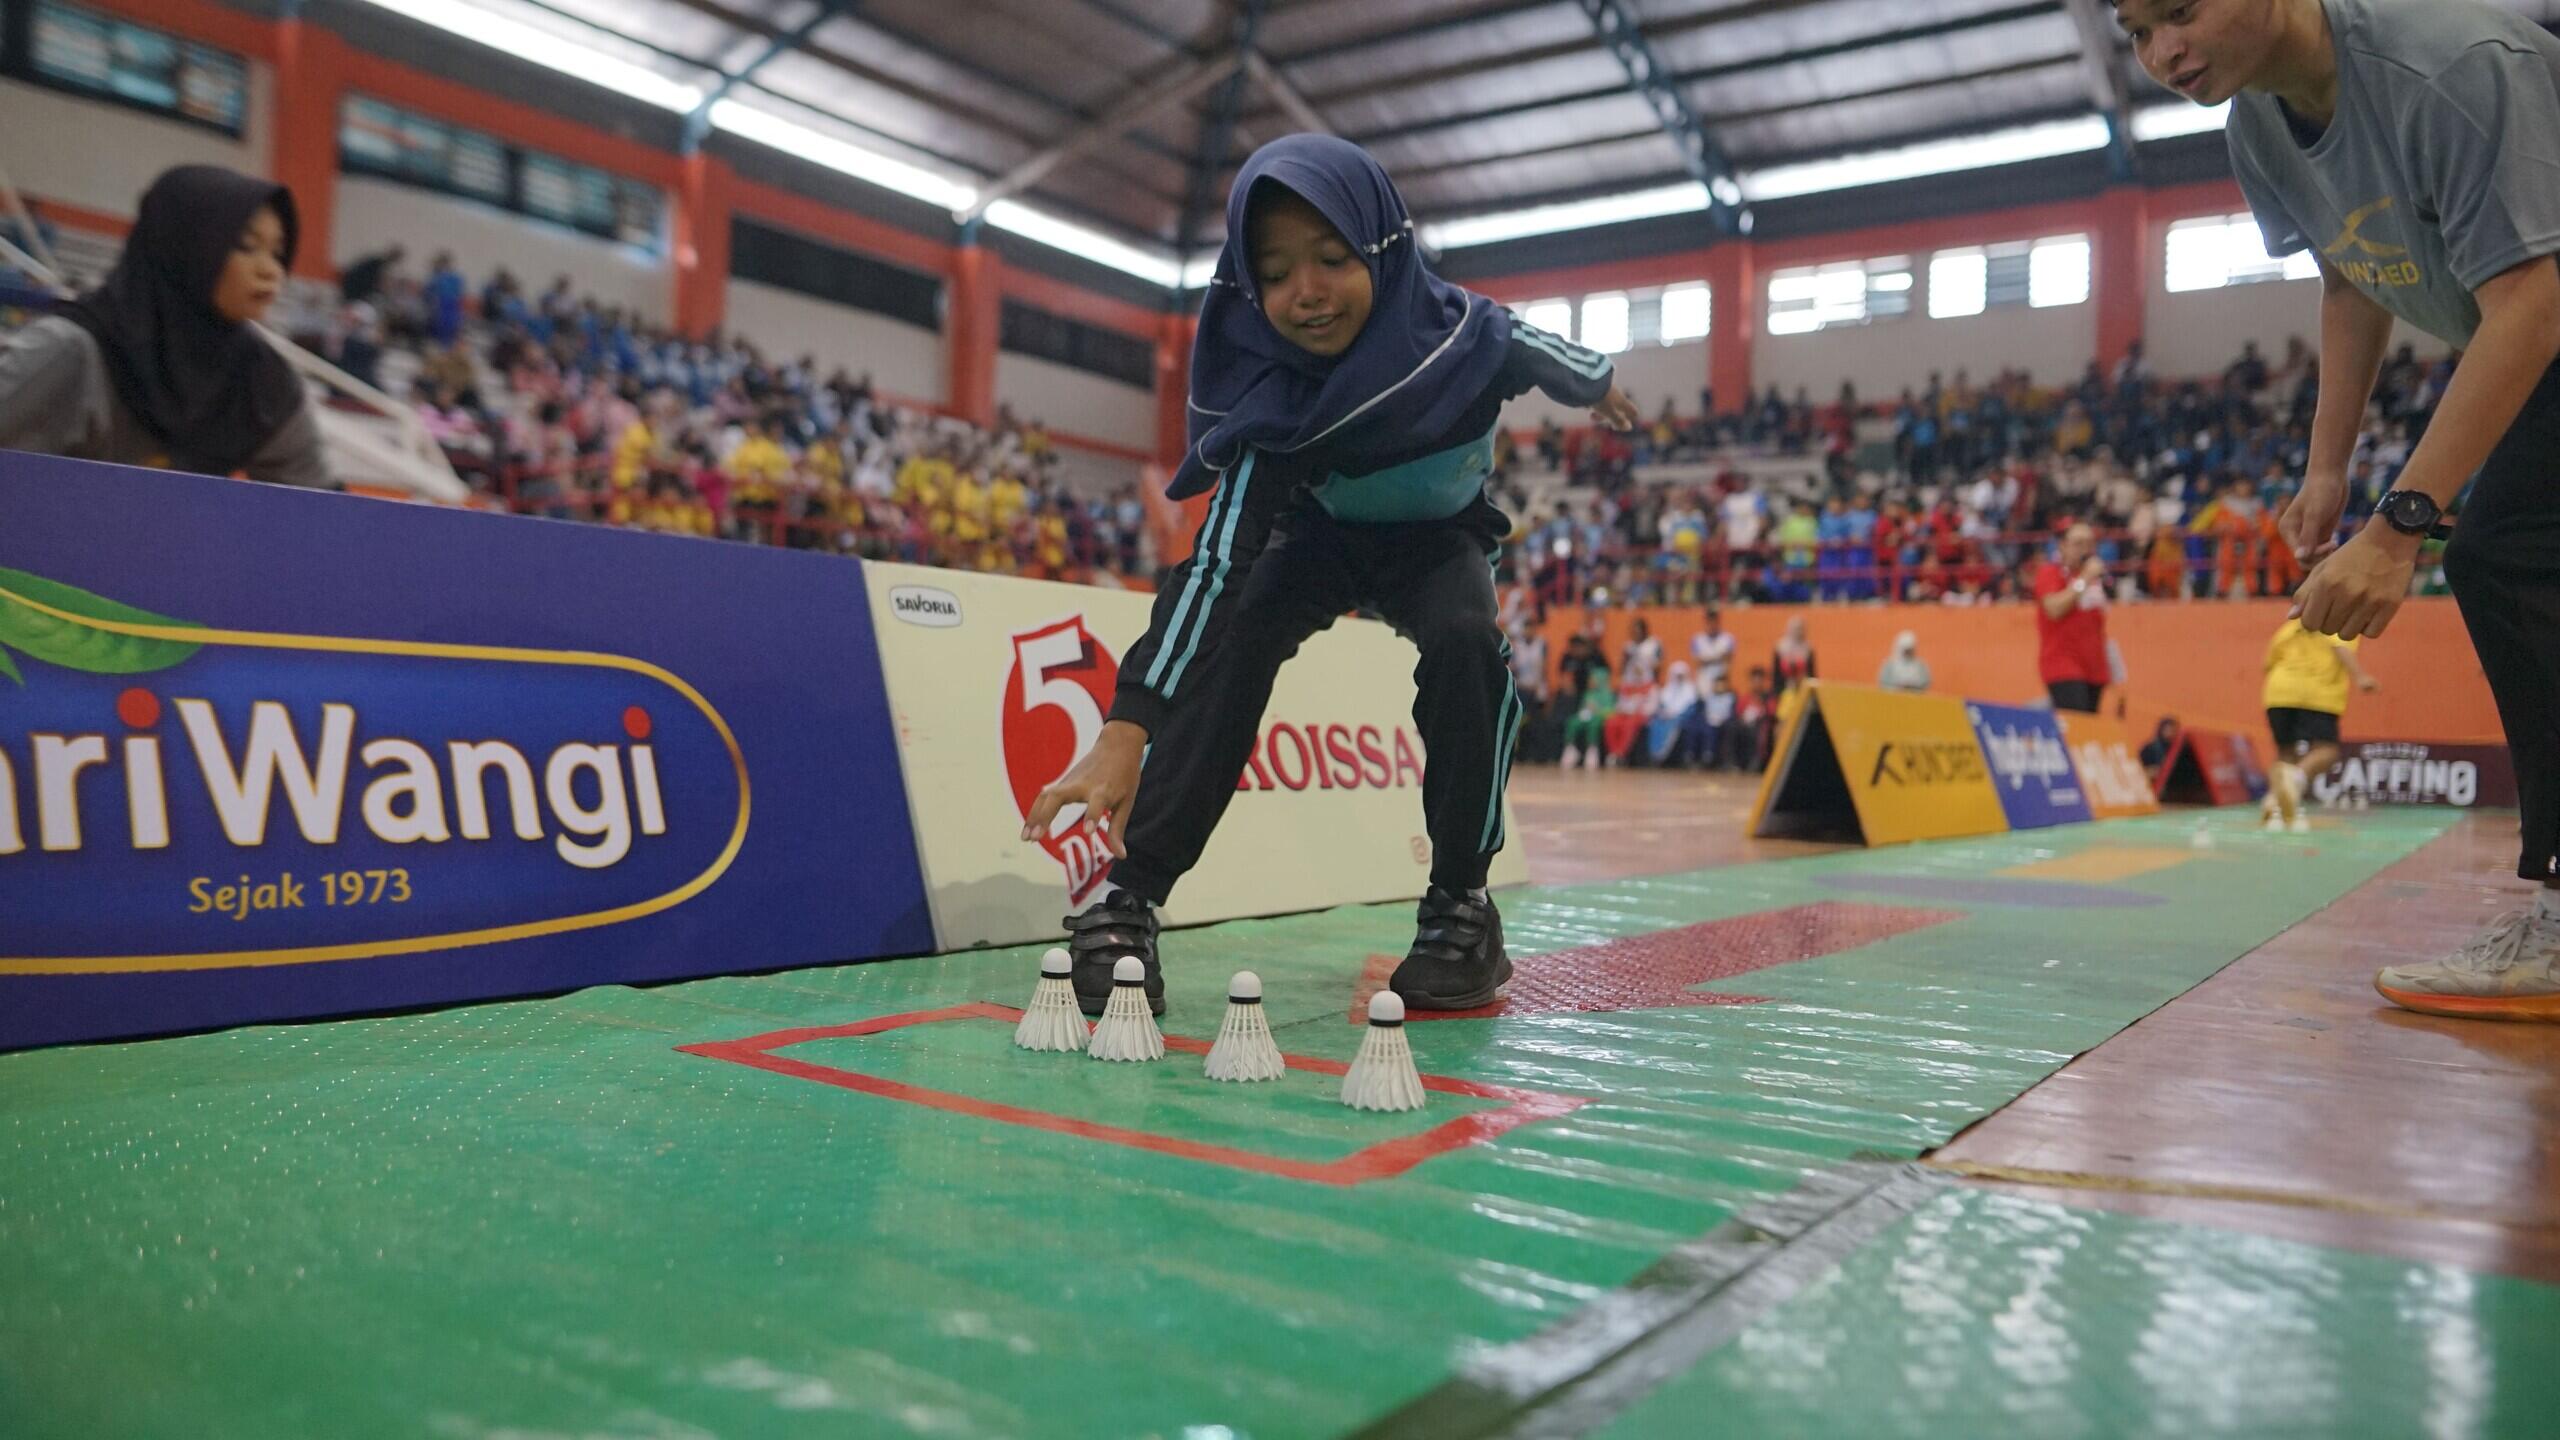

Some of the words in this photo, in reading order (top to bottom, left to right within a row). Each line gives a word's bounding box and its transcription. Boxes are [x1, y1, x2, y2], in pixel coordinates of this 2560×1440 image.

[896, 594, 956, 615] SAVORIA
[0, 688, 666, 868] riWangi
[1236, 722, 1425, 791] ROISSA
[188, 874, 305, 920] Sejak
[320, 868, 413, 906] 1973
